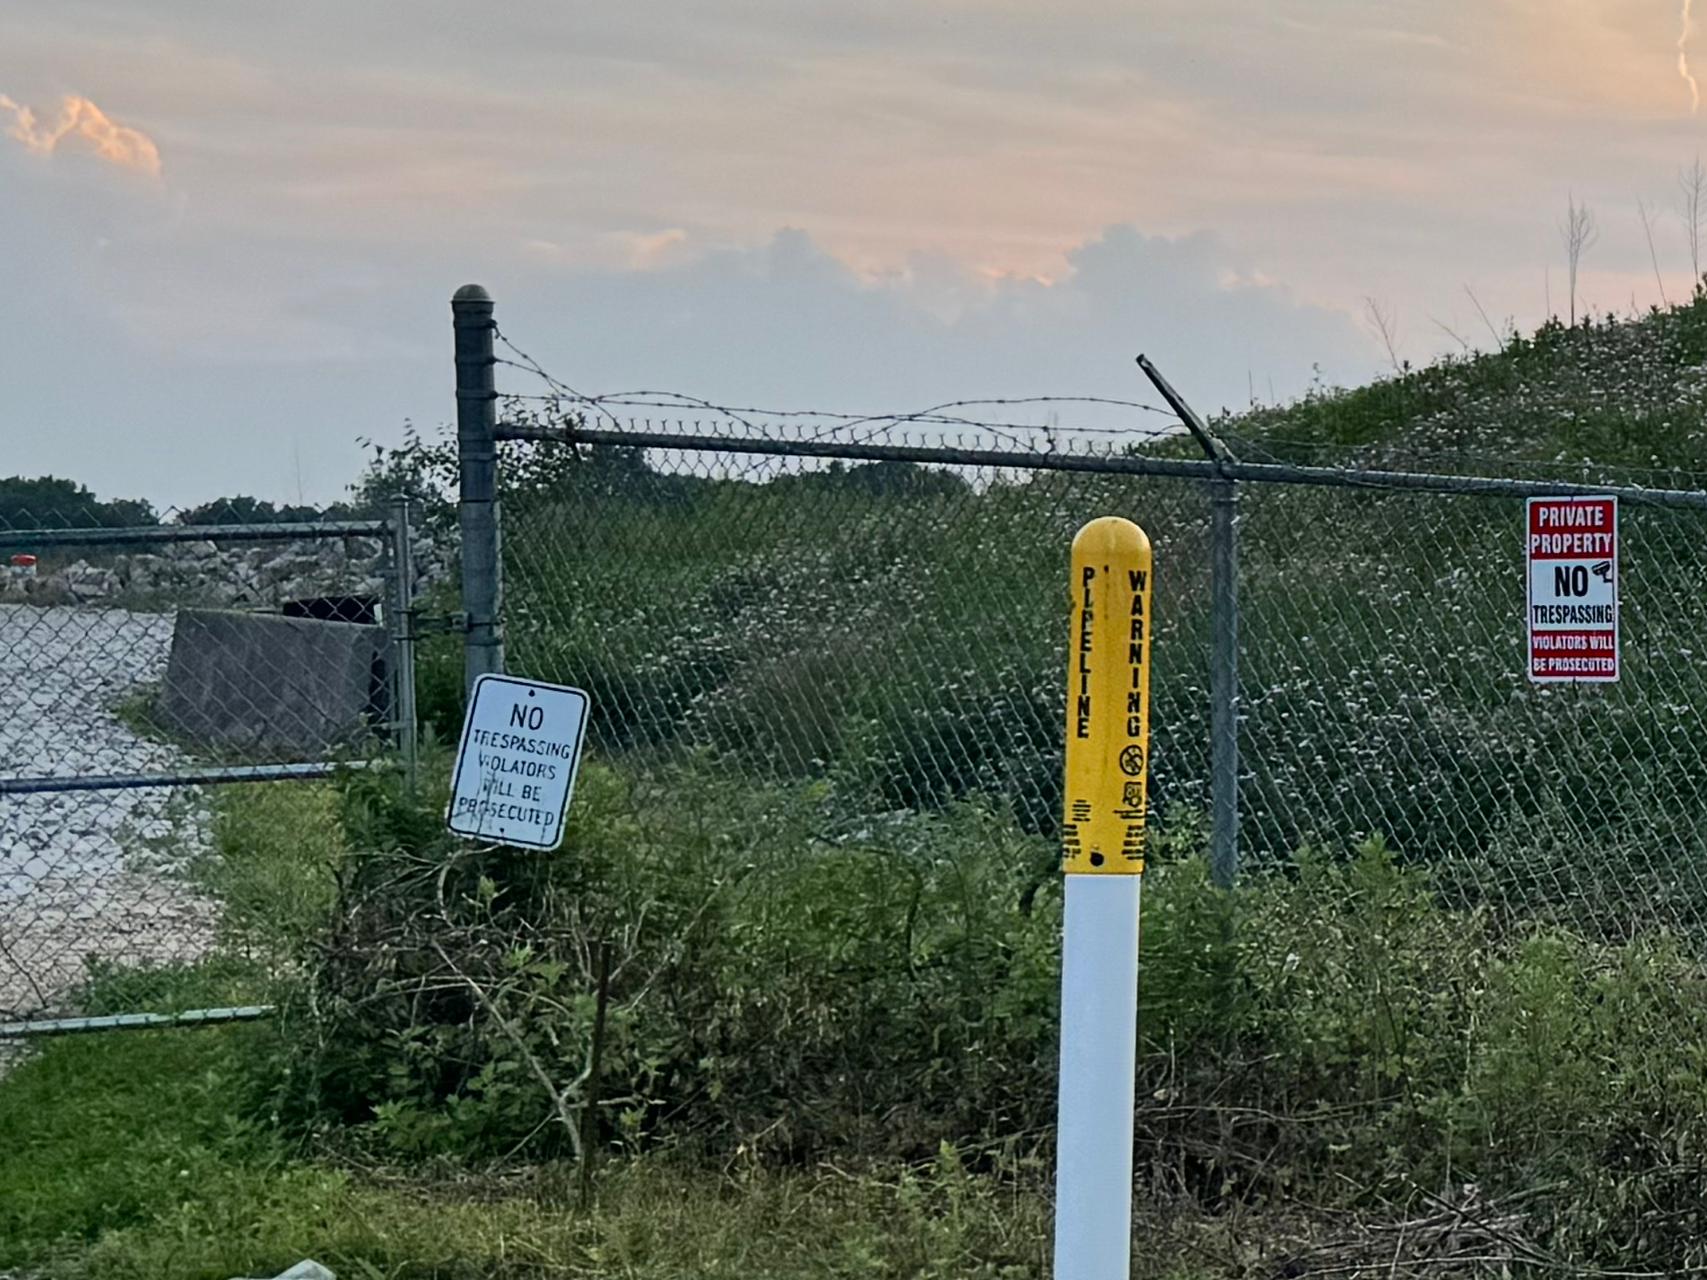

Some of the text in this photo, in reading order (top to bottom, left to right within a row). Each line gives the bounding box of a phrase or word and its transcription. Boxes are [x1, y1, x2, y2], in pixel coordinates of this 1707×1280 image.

[1539, 506, 1604, 527] PRIVATE
[1531, 532, 1612, 554] PROPERTY
[1554, 565, 1589, 597] NO
[1533, 604, 1613, 624] TRESPASSING
[1077, 566, 1096, 739] PIPELINE
[1532, 635, 1614, 650] VIOLATORS WILL
[1127, 570, 1147, 738] WARNING
[1533, 657, 1615, 672] BE PROSECUTED
[509, 703, 544, 731] NO
[474, 729, 571, 759] TRESPASSING
[521, 784, 542, 802] BE
